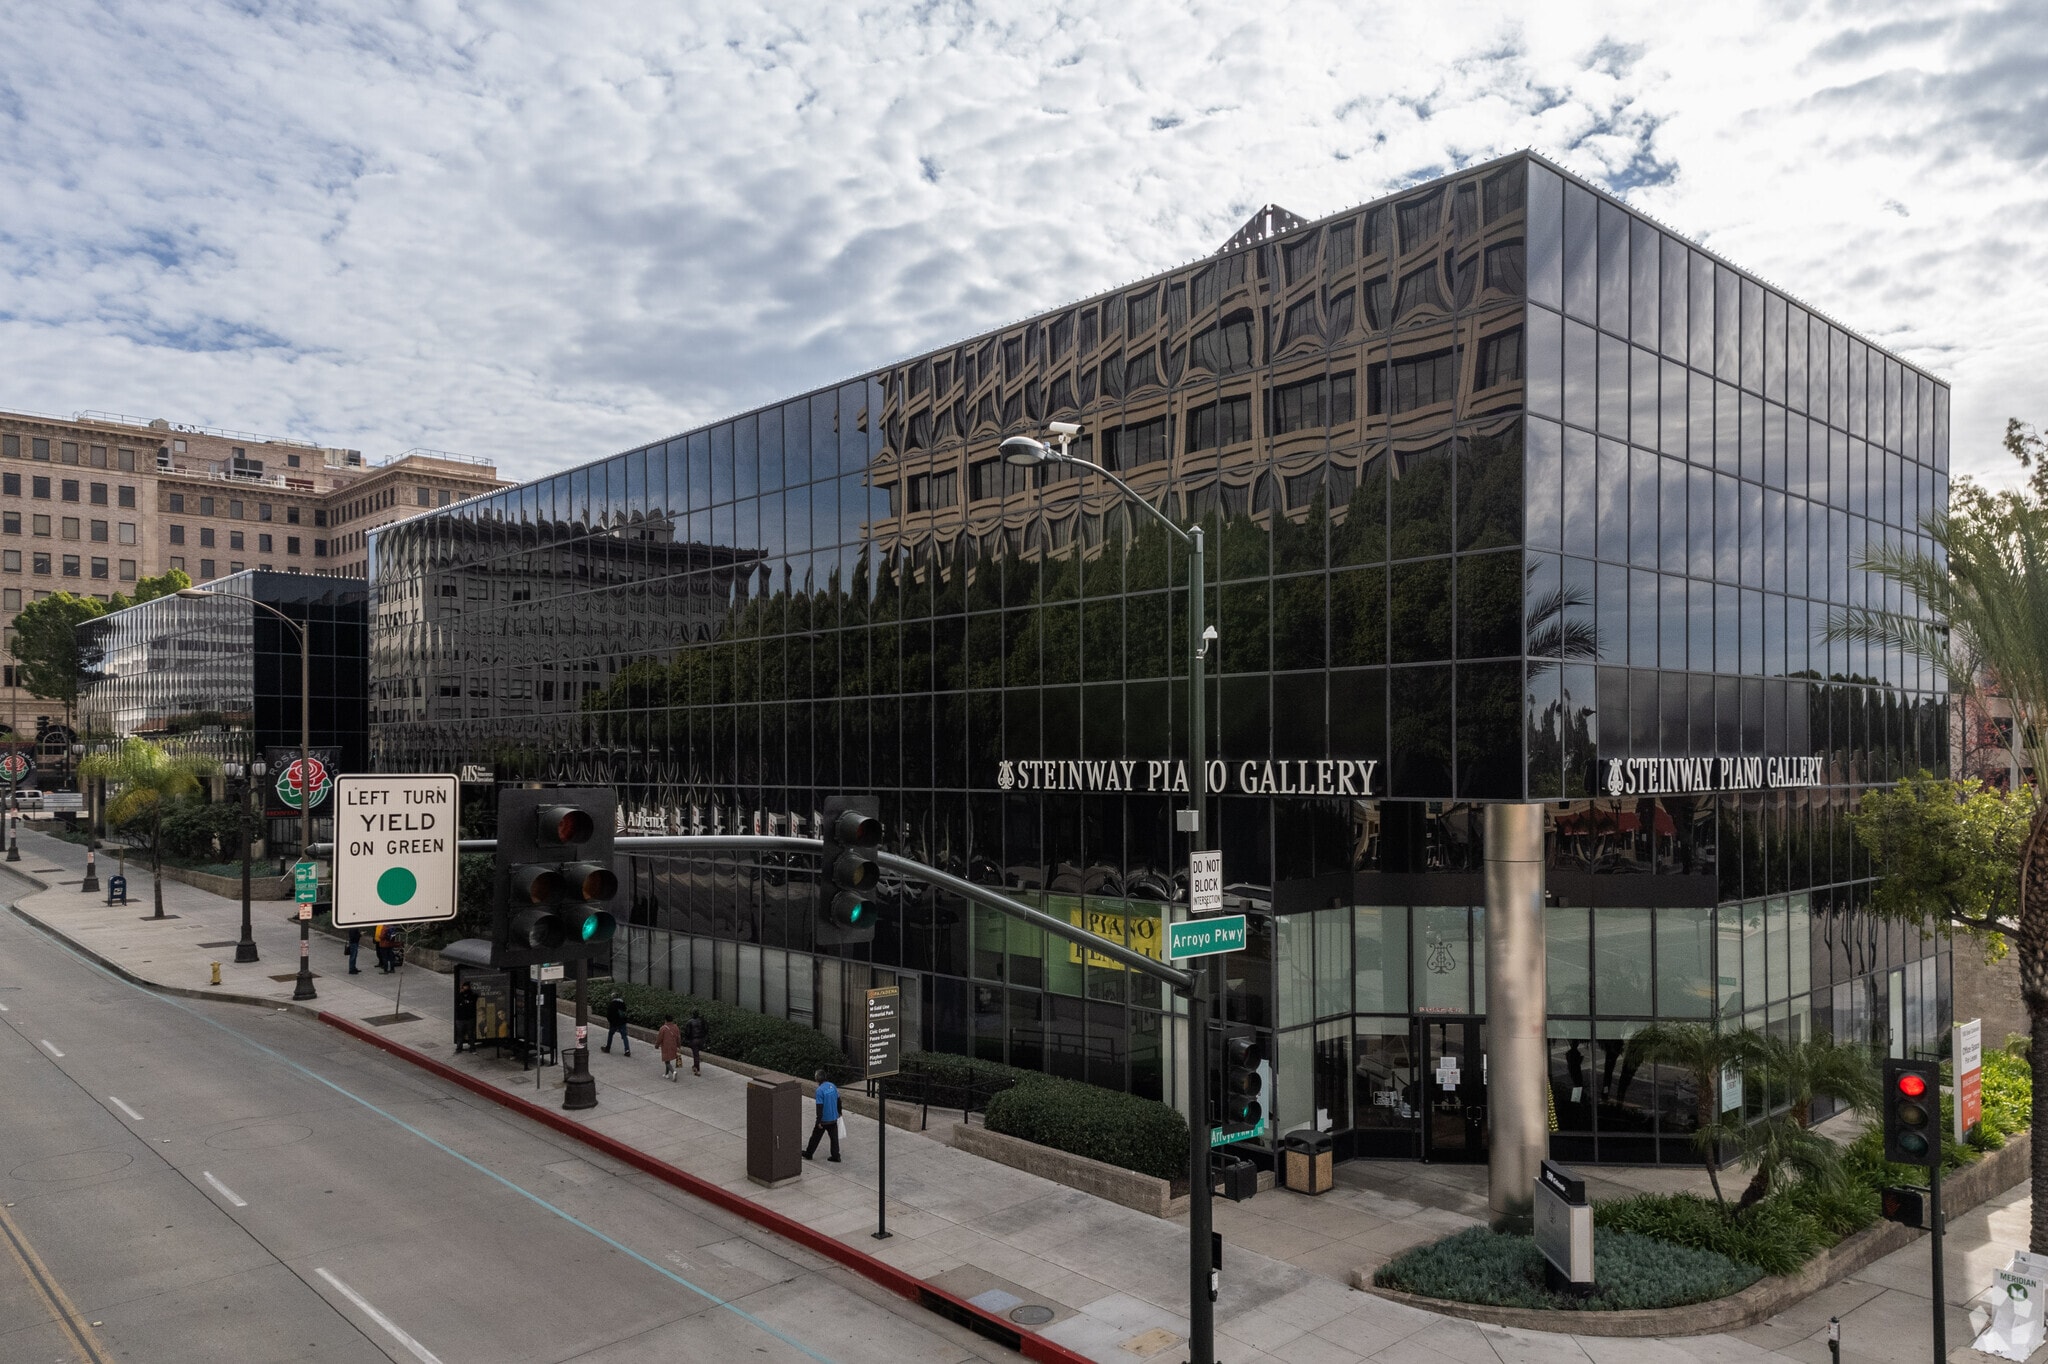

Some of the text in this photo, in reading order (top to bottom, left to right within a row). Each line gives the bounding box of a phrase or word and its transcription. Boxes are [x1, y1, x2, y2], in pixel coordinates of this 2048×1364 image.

[269, 751, 297, 775] ROSE
[309, 750, 339, 776] PARAD
[461, 765, 477, 782] AIS
[1018, 760, 1378, 795] STEINWAY PIAO GALLERY
[1626, 756, 1823, 794] STEINWAY PIANO GALLERY
[348, 789, 446, 806] LEFT TURN
[360, 813, 435, 832] YIELD
[350, 839, 443, 856] ON GREEN
[1193, 859, 1219, 874] DO NOT
[1195, 878, 1218, 893] BLOCK
[1194, 895, 1220, 905] INTERSECTION
[1173, 928, 1243, 948] Arroyo Pkwy
[2000, 1272, 2037, 1288] MERIDIAN
